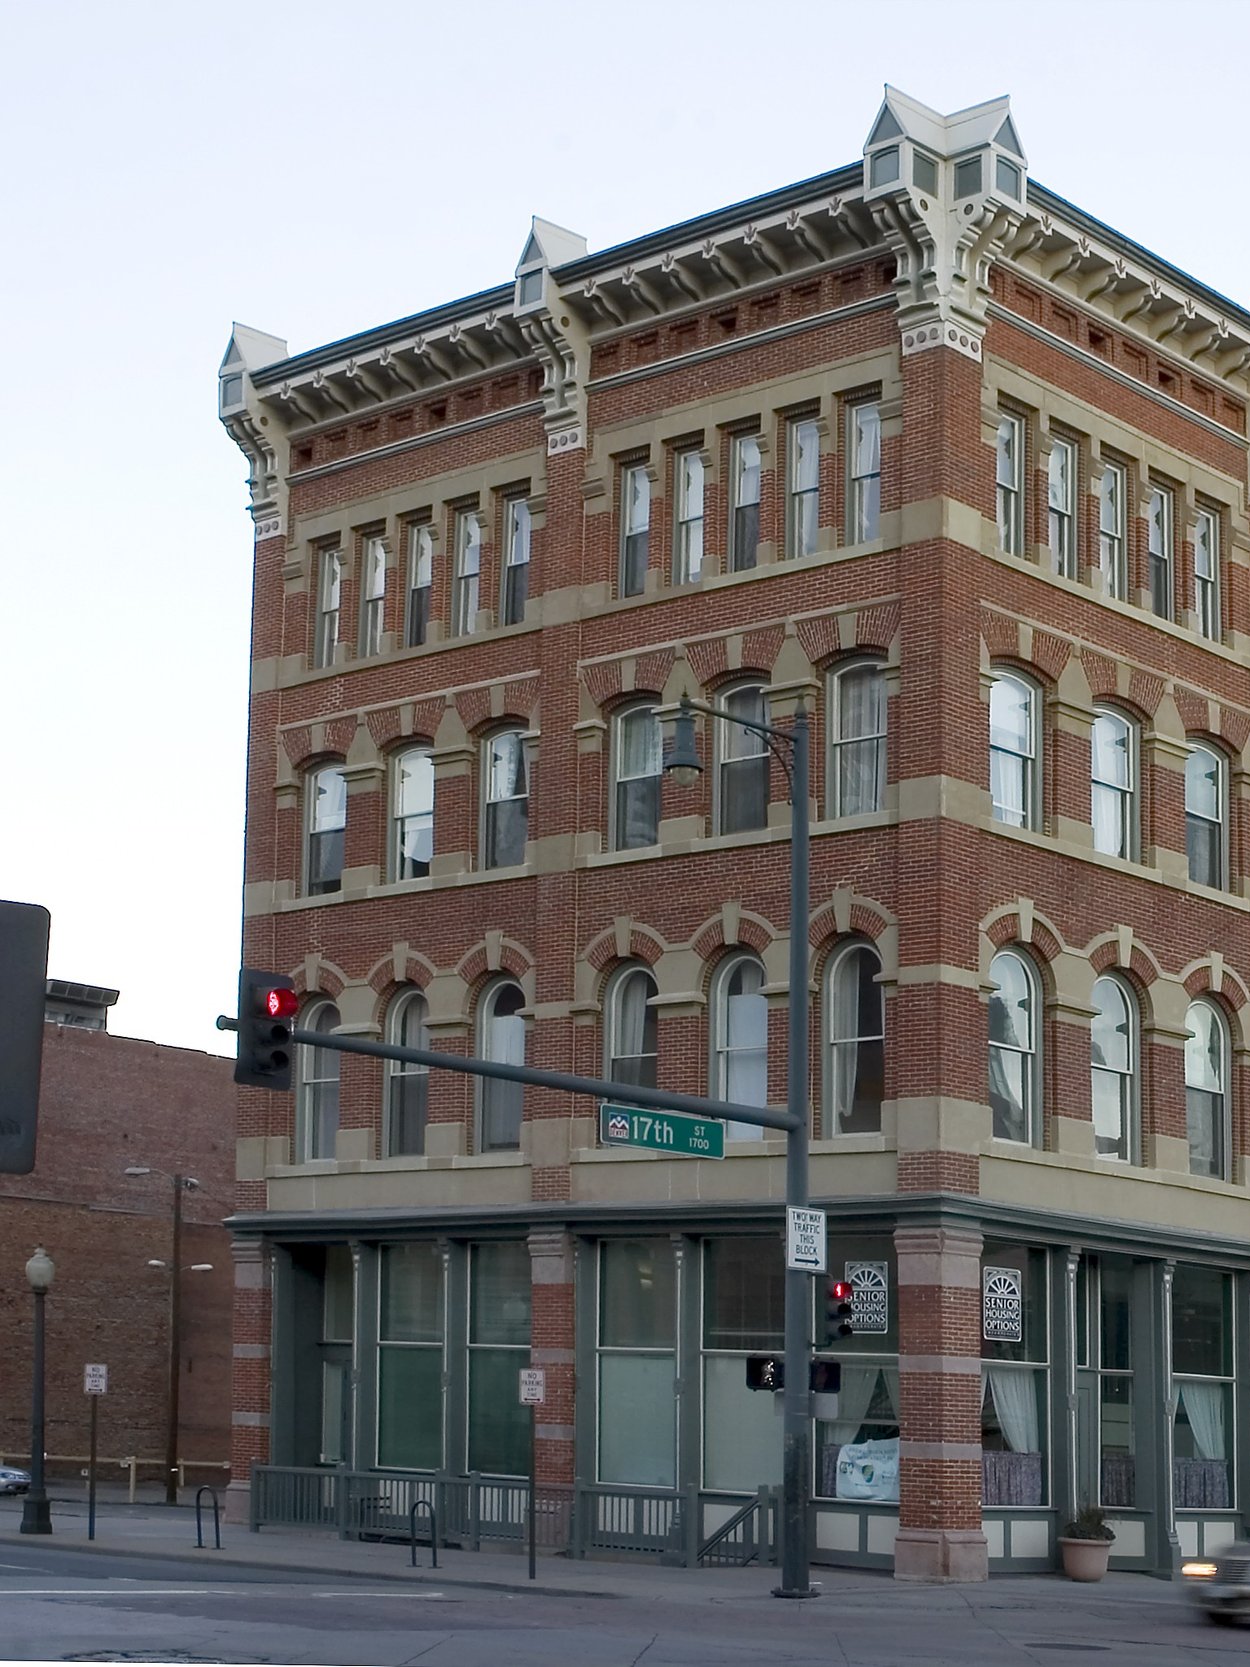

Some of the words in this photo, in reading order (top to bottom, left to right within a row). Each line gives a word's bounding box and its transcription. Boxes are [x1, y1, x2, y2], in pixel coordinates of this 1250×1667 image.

[632, 1115, 674, 1145] 17th
[694, 1126, 705, 1136] ST
[689, 1138, 709, 1150] 1700
[792, 1211, 807, 1222] TWO
[809, 1213, 821, 1223] WAY
[794, 1222, 820, 1234] TRAFFIC
[800, 1234, 814, 1244] THIS
[796, 1245, 817, 1256] BLOCK
[985, 1297, 1019, 1310] SENIOR
[985, 1308, 1020, 1320] HOUSING
[985, 1319, 1020, 1331] OPTIONS
[527, 1372, 537, 1380] NO
